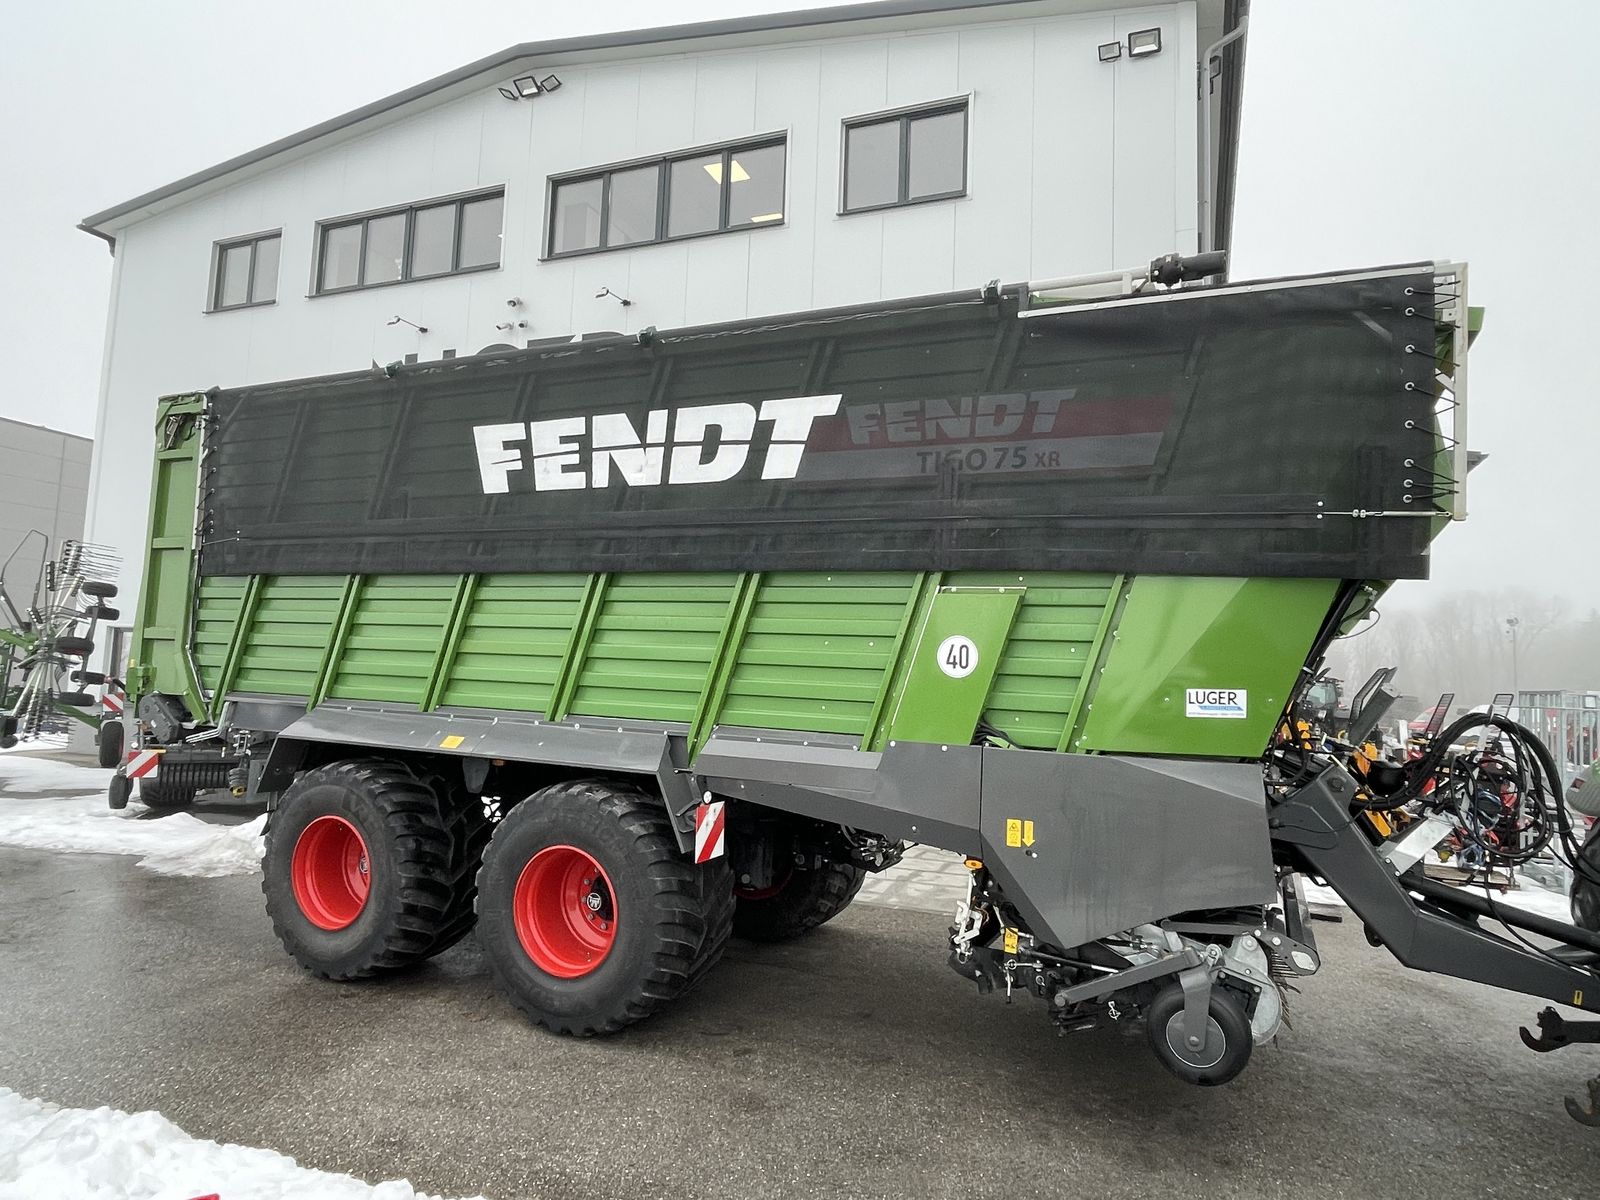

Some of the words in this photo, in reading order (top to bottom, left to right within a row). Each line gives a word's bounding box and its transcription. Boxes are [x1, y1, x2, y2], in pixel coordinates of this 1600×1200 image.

[846, 388, 1077, 445] FENDT
[473, 394, 843, 494] FENDT
[993, 446, 1028, 470] 75
[1034, 451, 1061, 468] XR
[946, 644, 969, 669] 40
[1188, 691, 1238, 705] LUGER
